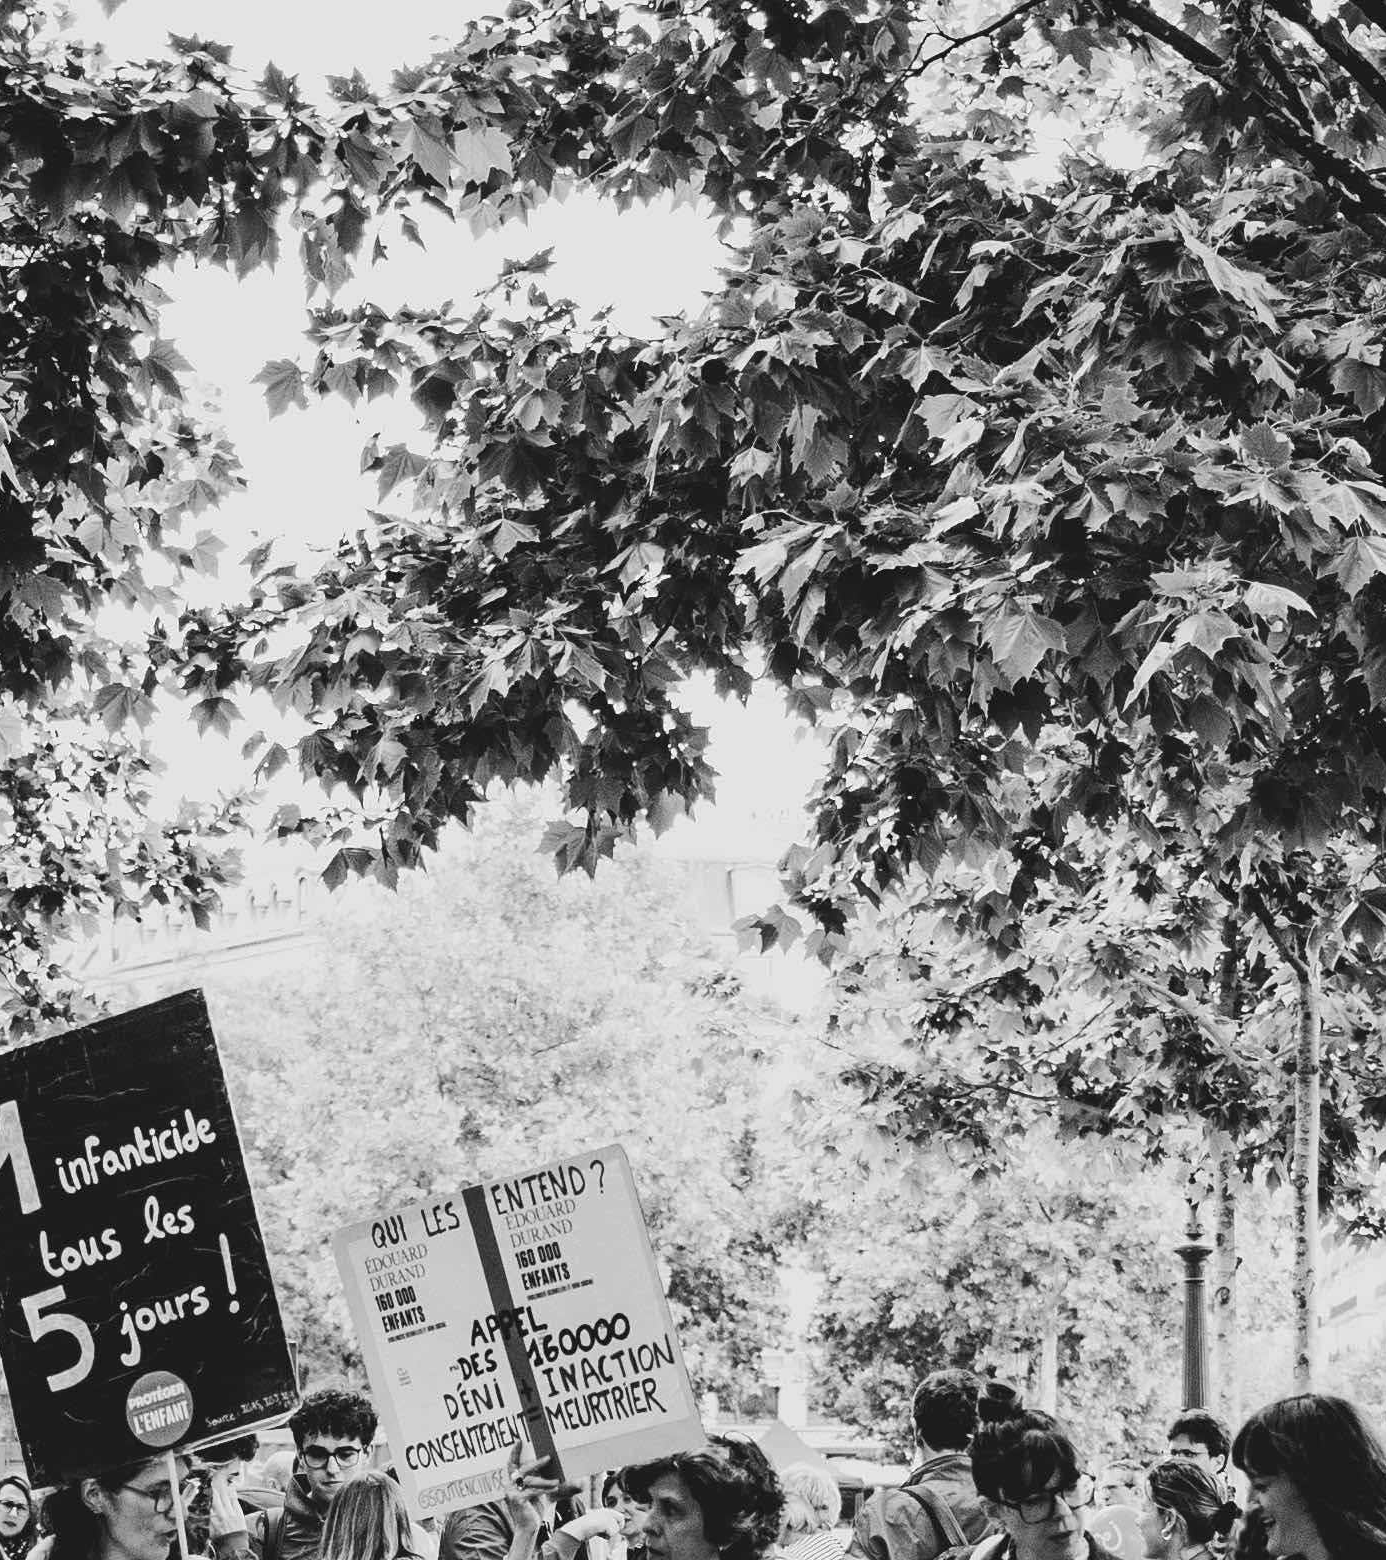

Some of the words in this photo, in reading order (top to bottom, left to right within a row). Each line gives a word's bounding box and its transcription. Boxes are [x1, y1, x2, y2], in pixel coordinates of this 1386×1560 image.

[56, 1108, 217, 1195] infanticide
[371, 1214, 408, 1248] QUI
[421, 1200, 461, 1238] LES
[490, 1165, 586, 1215] ENTEND
[39, 1229, 123, 1279] tous
[143, 1195, 196, 1245] les
[509, 1218, 573, 1248] DURAND
[515, 1248, 537, 1269] 160
[536, 1241, 562, 1263] 000
[369, 1263, 426, 1291] DURAND
[521, 1262, 571, 1290] ENFANTS
[20, 1284, 96, 1394] 5
[119, 1285, 211, 1368] jours
[219, 1232, 241, 1315] !
[375, 1292, 395, 1312] 160
[394, 1285, 417, 1307] 000
[381, 1305, 426, 1333] ENFANTS
[470, 1306, 548, 1346] APPEL
[456, 1348, 497, 1382] DES
[526, 1312, 631, 1367] 160000
[542, 1333, 675, 1398] INACTION
[132, 1401, 190, 1435] L'ENFANT
[405, 1411, 532, 1471] CONSENTEMENT
